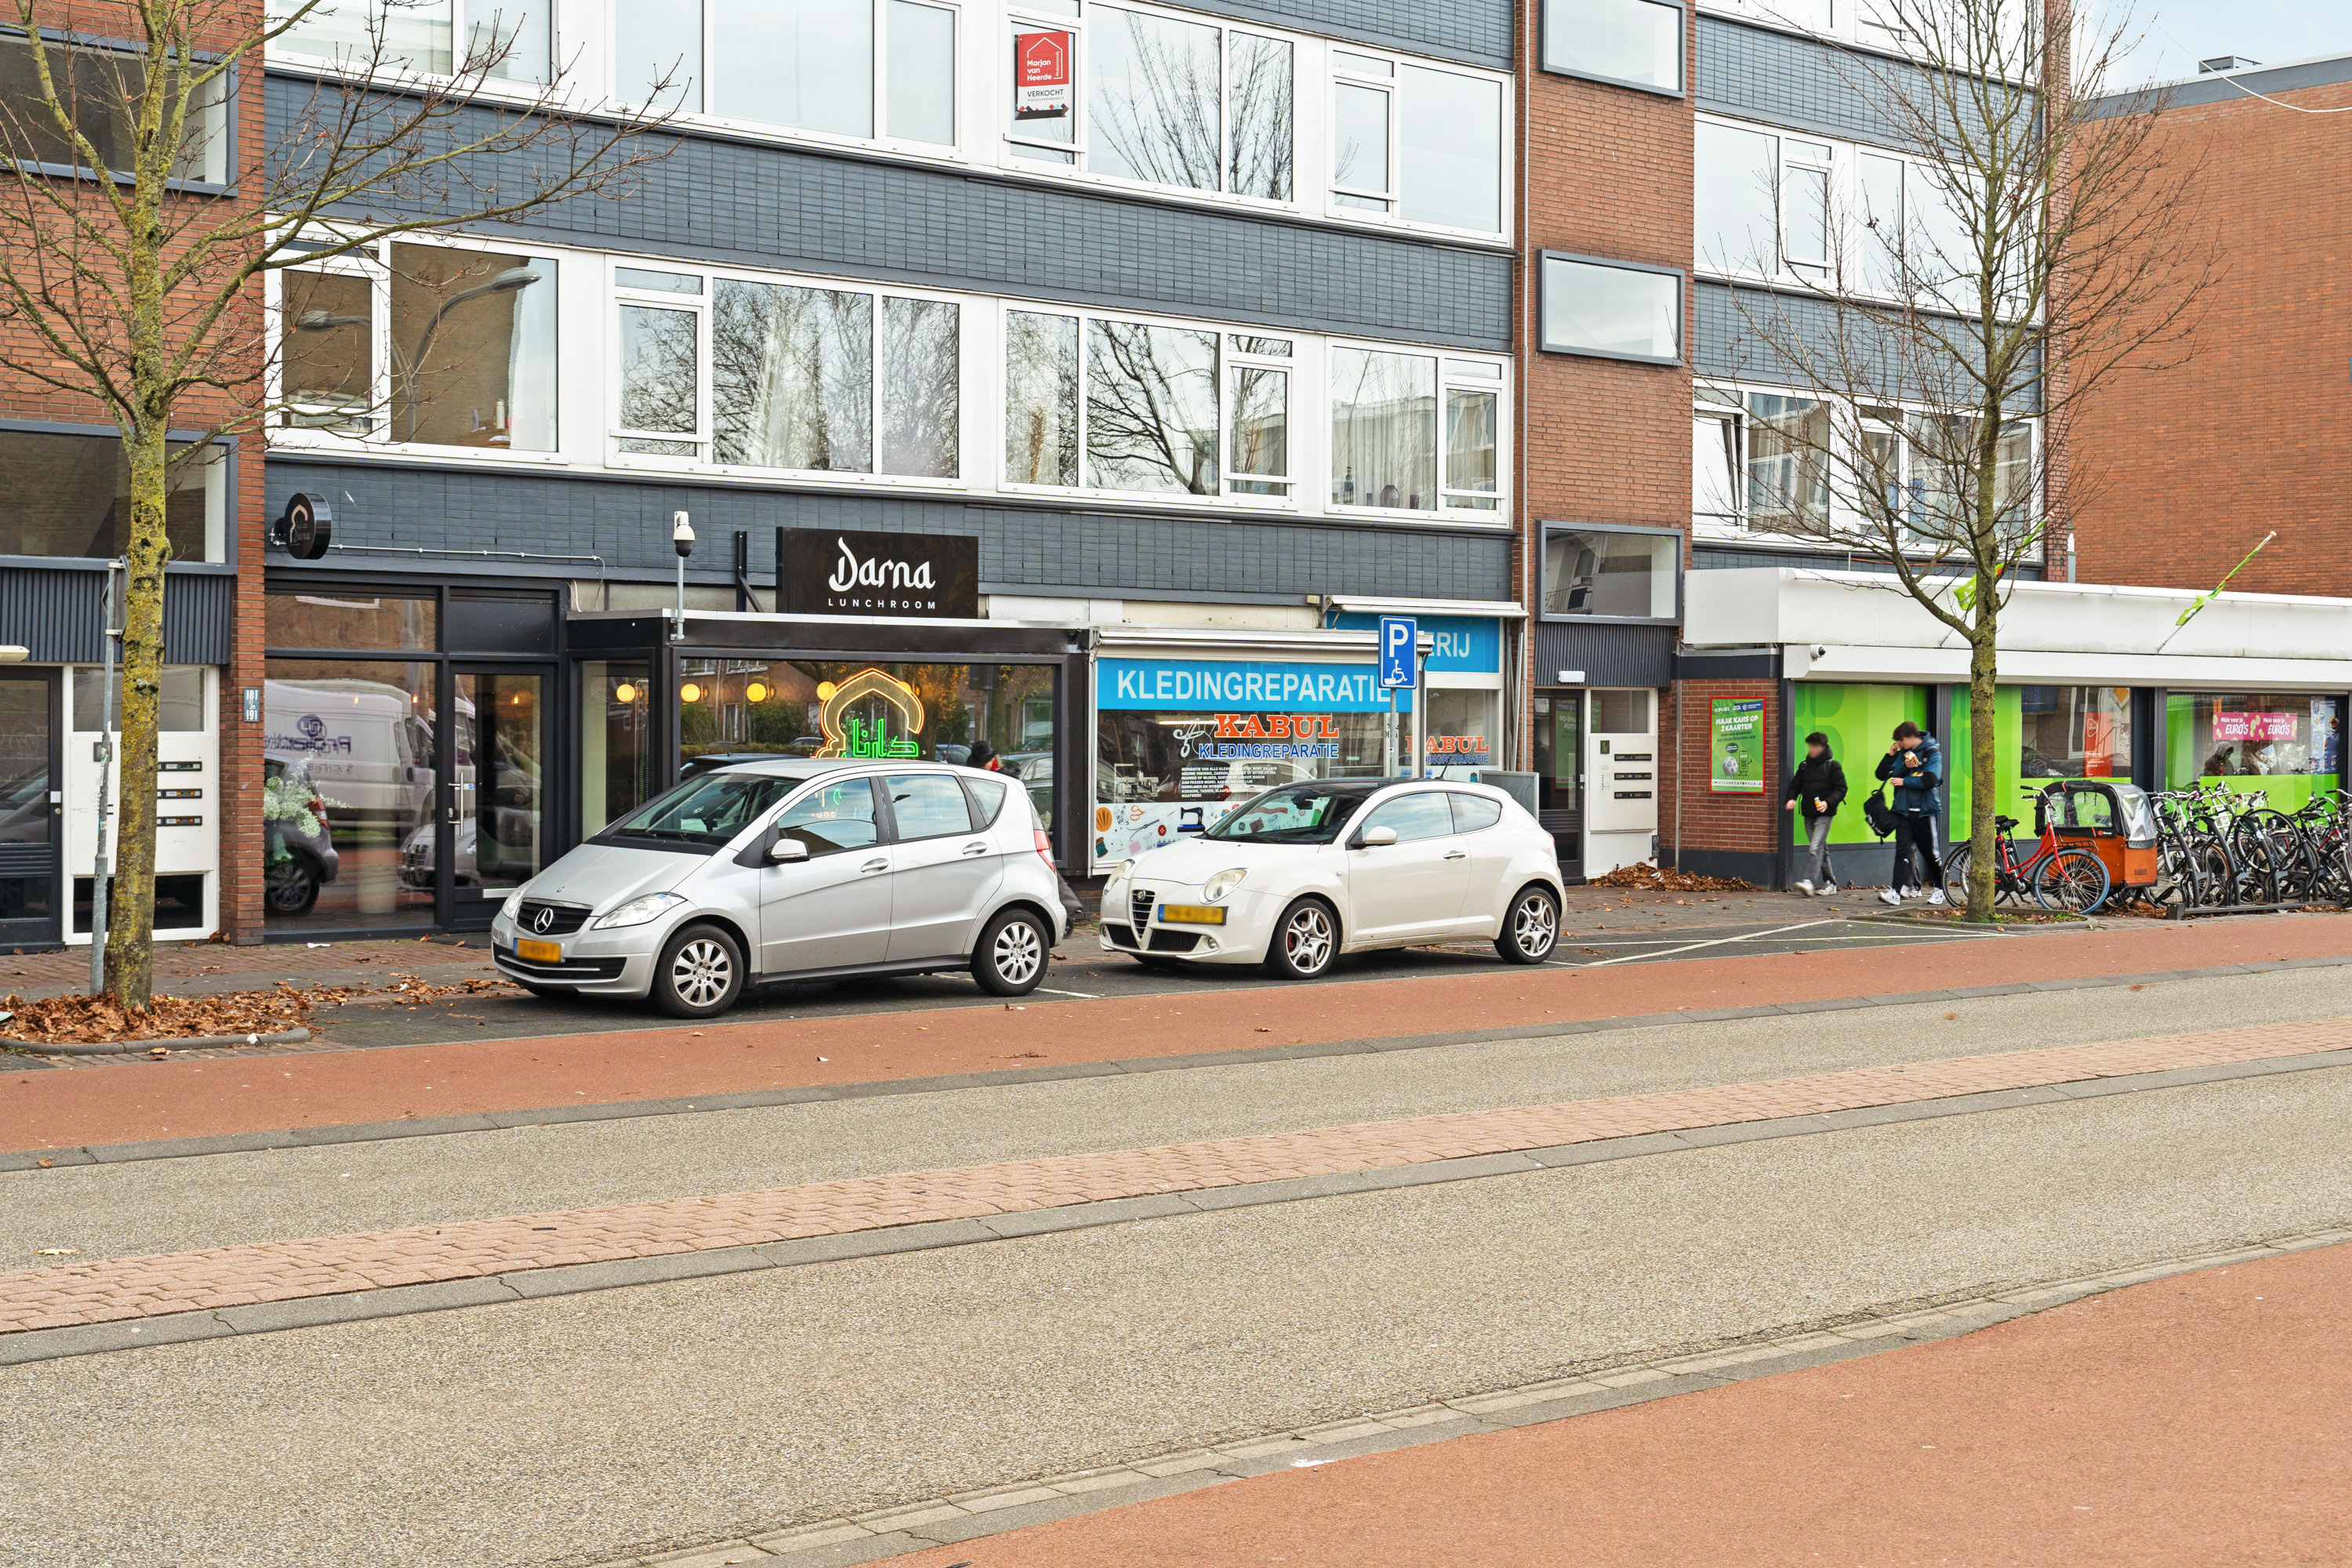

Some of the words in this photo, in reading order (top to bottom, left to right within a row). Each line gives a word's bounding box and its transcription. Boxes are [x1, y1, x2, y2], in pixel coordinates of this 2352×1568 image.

[1027, 59, 1051, 67] Marjan
[1027, 89, 1064, 97] VERKOCHT
[828, 536, 936, 592] Darna
[828, 598, 936, 609] LUNCHROOM
[1388, 623, 1409, 657] P
[1117, 669, 1392, 702] KLEDINGREPARATIE
[246, 689, 258, 700] 181
[246, 710, 258, 720] 191
[1214, 713, 1339, 739] KABUL
[1726, 723, 1752, 731] KAARTEN
[2225, 721, 2249, 735] EURO'S
[2267, 722, 2290, 735] EURO'S
[1198, 742, 1339, 759] KLEDINGREPARATIE
[1405, 753, 1490, 764] KINGREPARATIE
[2241, 796, 2265, 808] PUS
